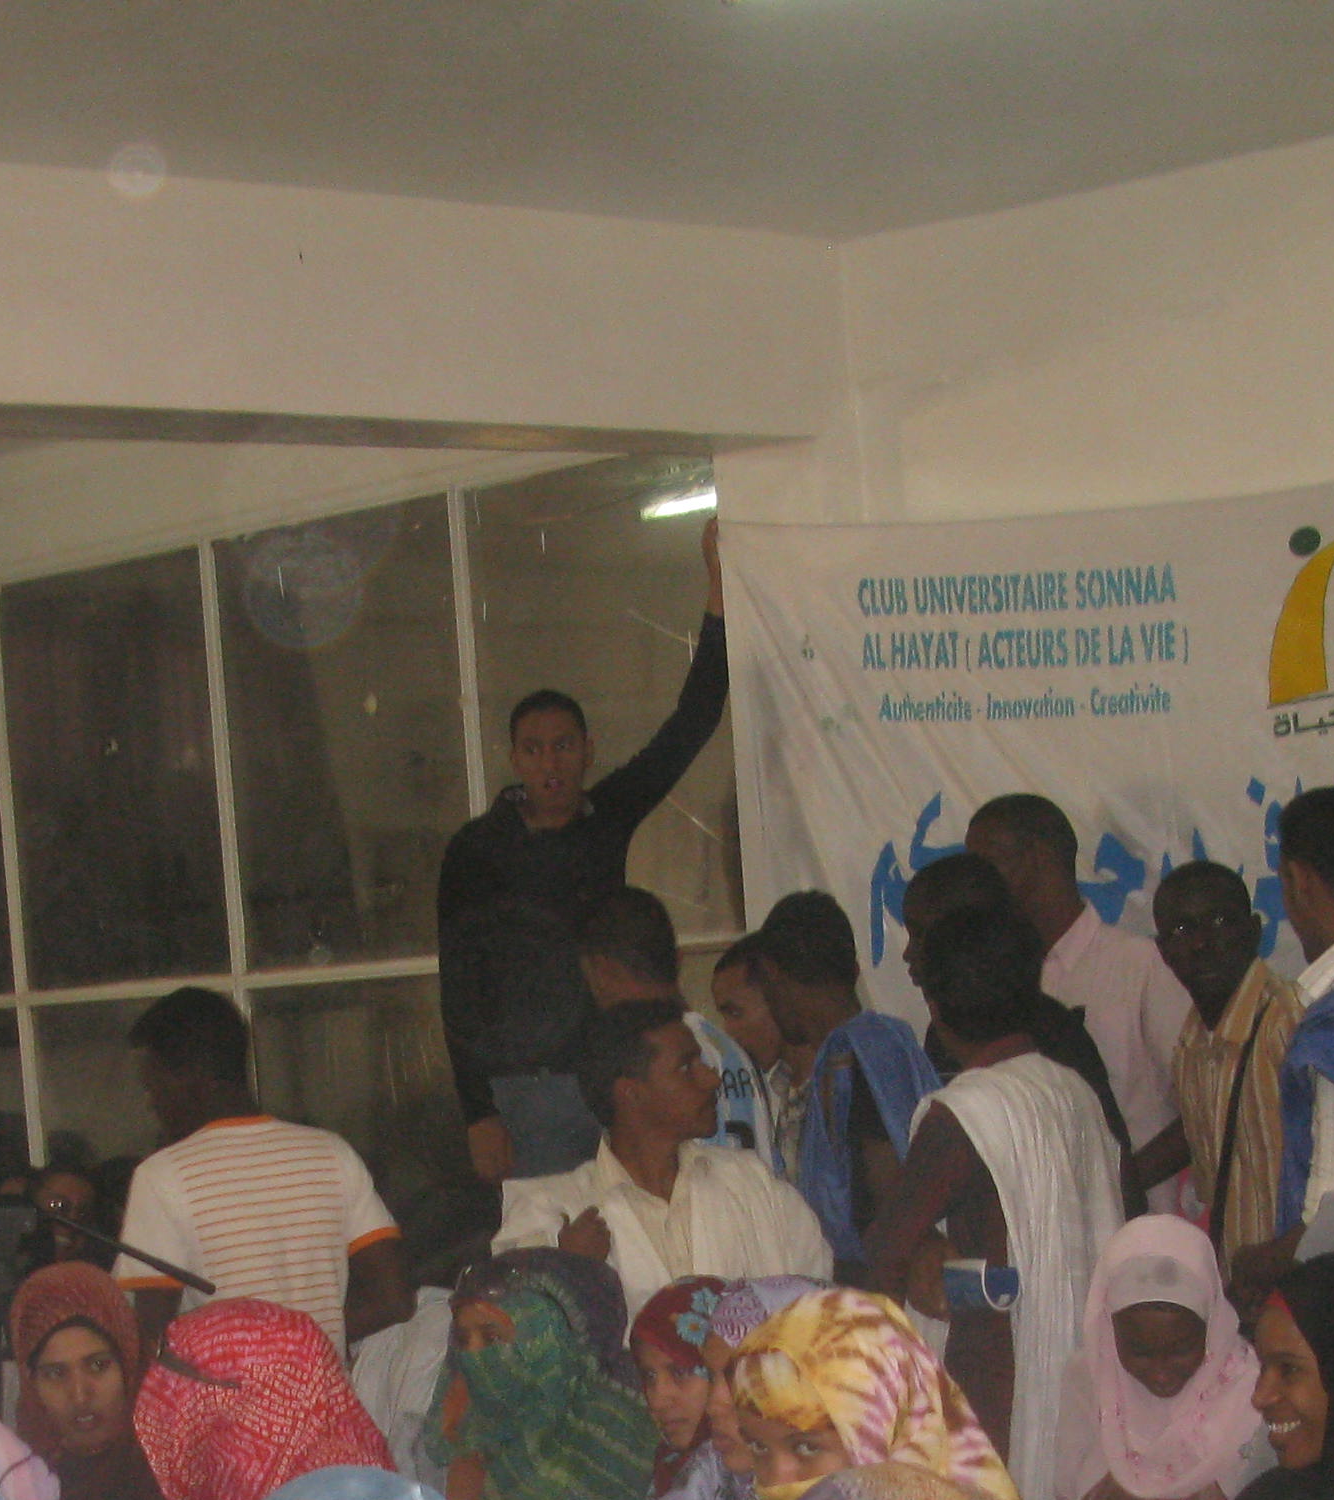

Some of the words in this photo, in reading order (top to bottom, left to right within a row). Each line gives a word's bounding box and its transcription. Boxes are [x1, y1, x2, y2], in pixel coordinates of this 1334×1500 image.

[857, 576, 908, 617] CLUB
[912, 570, 1069, 615] UNIVERSITAIRE
[1075, 561, 1176, 611] SONNAA
[862, 632, 887, 670] AL
[890, 631, 959, 670] HAYAT
[978, 627, 1069, 670] ACTEURS
[1075, 624, 1102, 668] DE
[1107, 623, 1135, 667] LA
[1139, 620, 1176, 664] VIE
[986, 686, 1075, 721] Innovation
